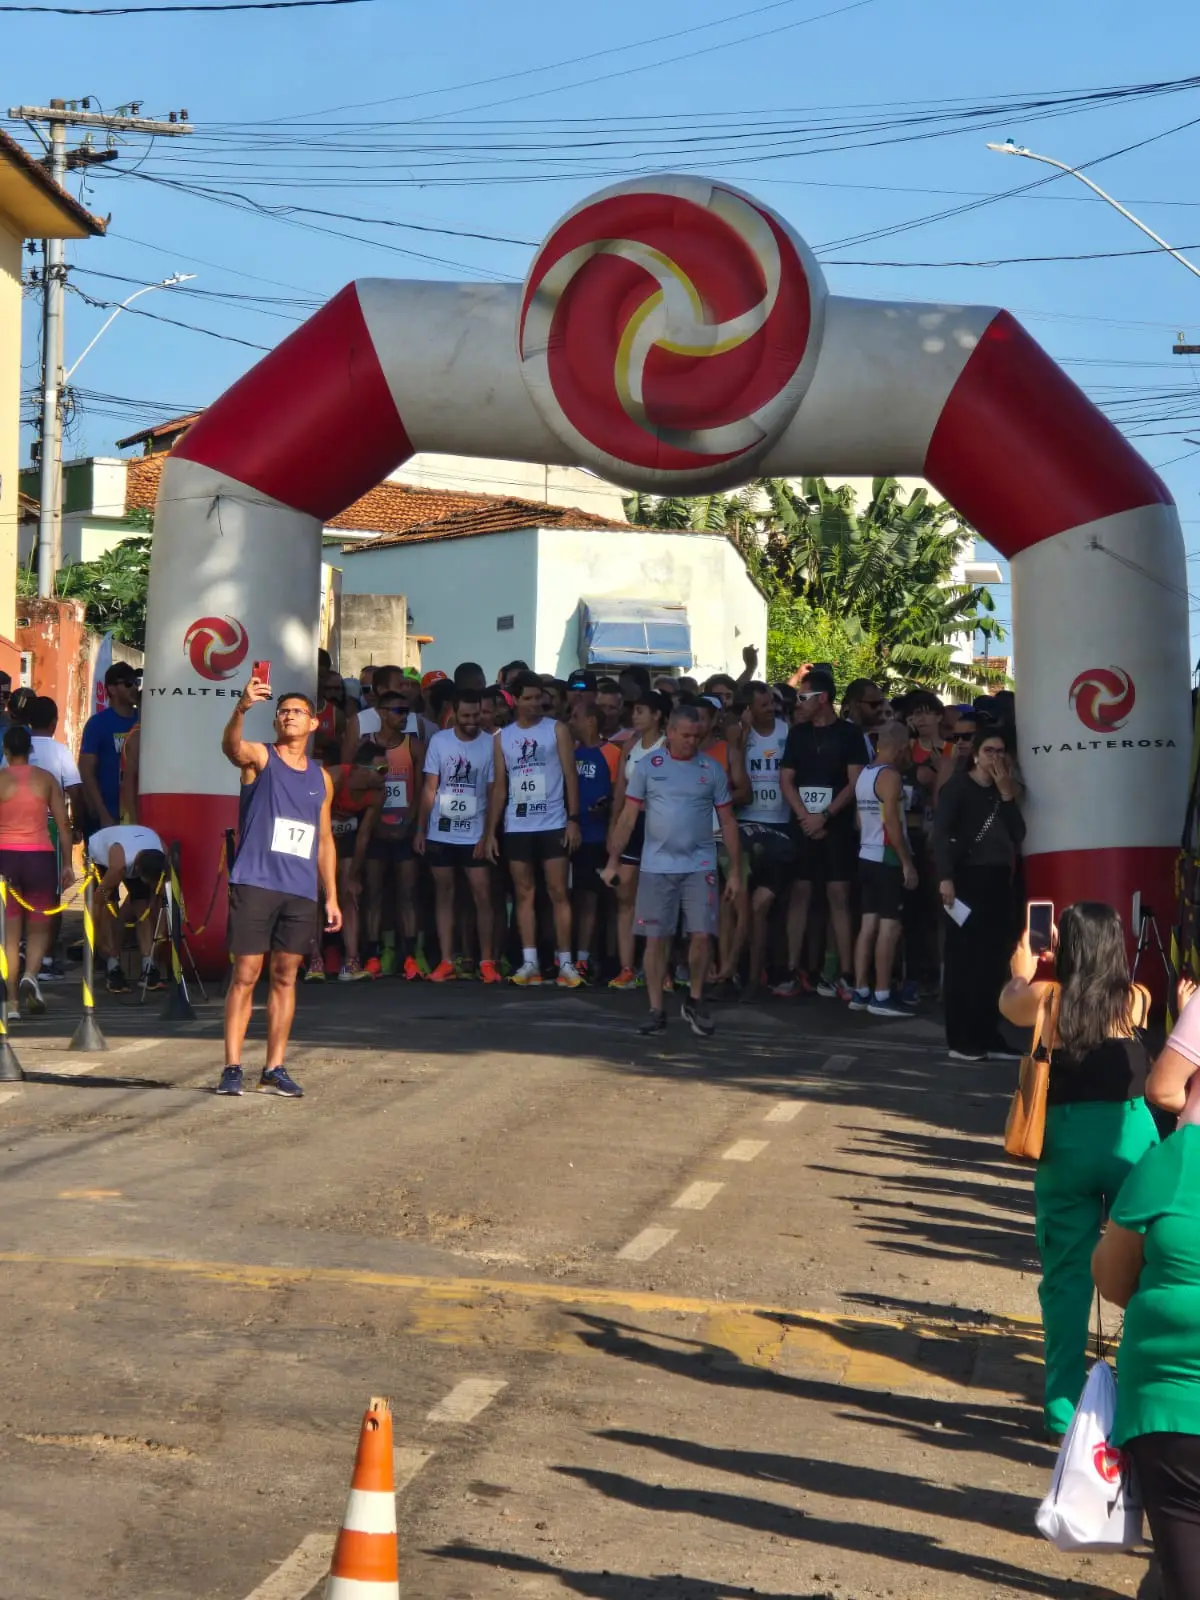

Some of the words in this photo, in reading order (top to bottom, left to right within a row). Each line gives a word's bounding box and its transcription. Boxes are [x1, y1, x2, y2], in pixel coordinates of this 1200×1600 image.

[149, 687, 167, 697] TV
[1031, 745, 1053, 755] TV
[1060, 739, 1177, 752] ALTEROSA
[520, 780, 536, 792] 46
[754, 789, 777, 801] 100
[803, 791, 827, 803] 287
[450, 800, 467, 812] 26
[288, 827, 306, 843] 17
